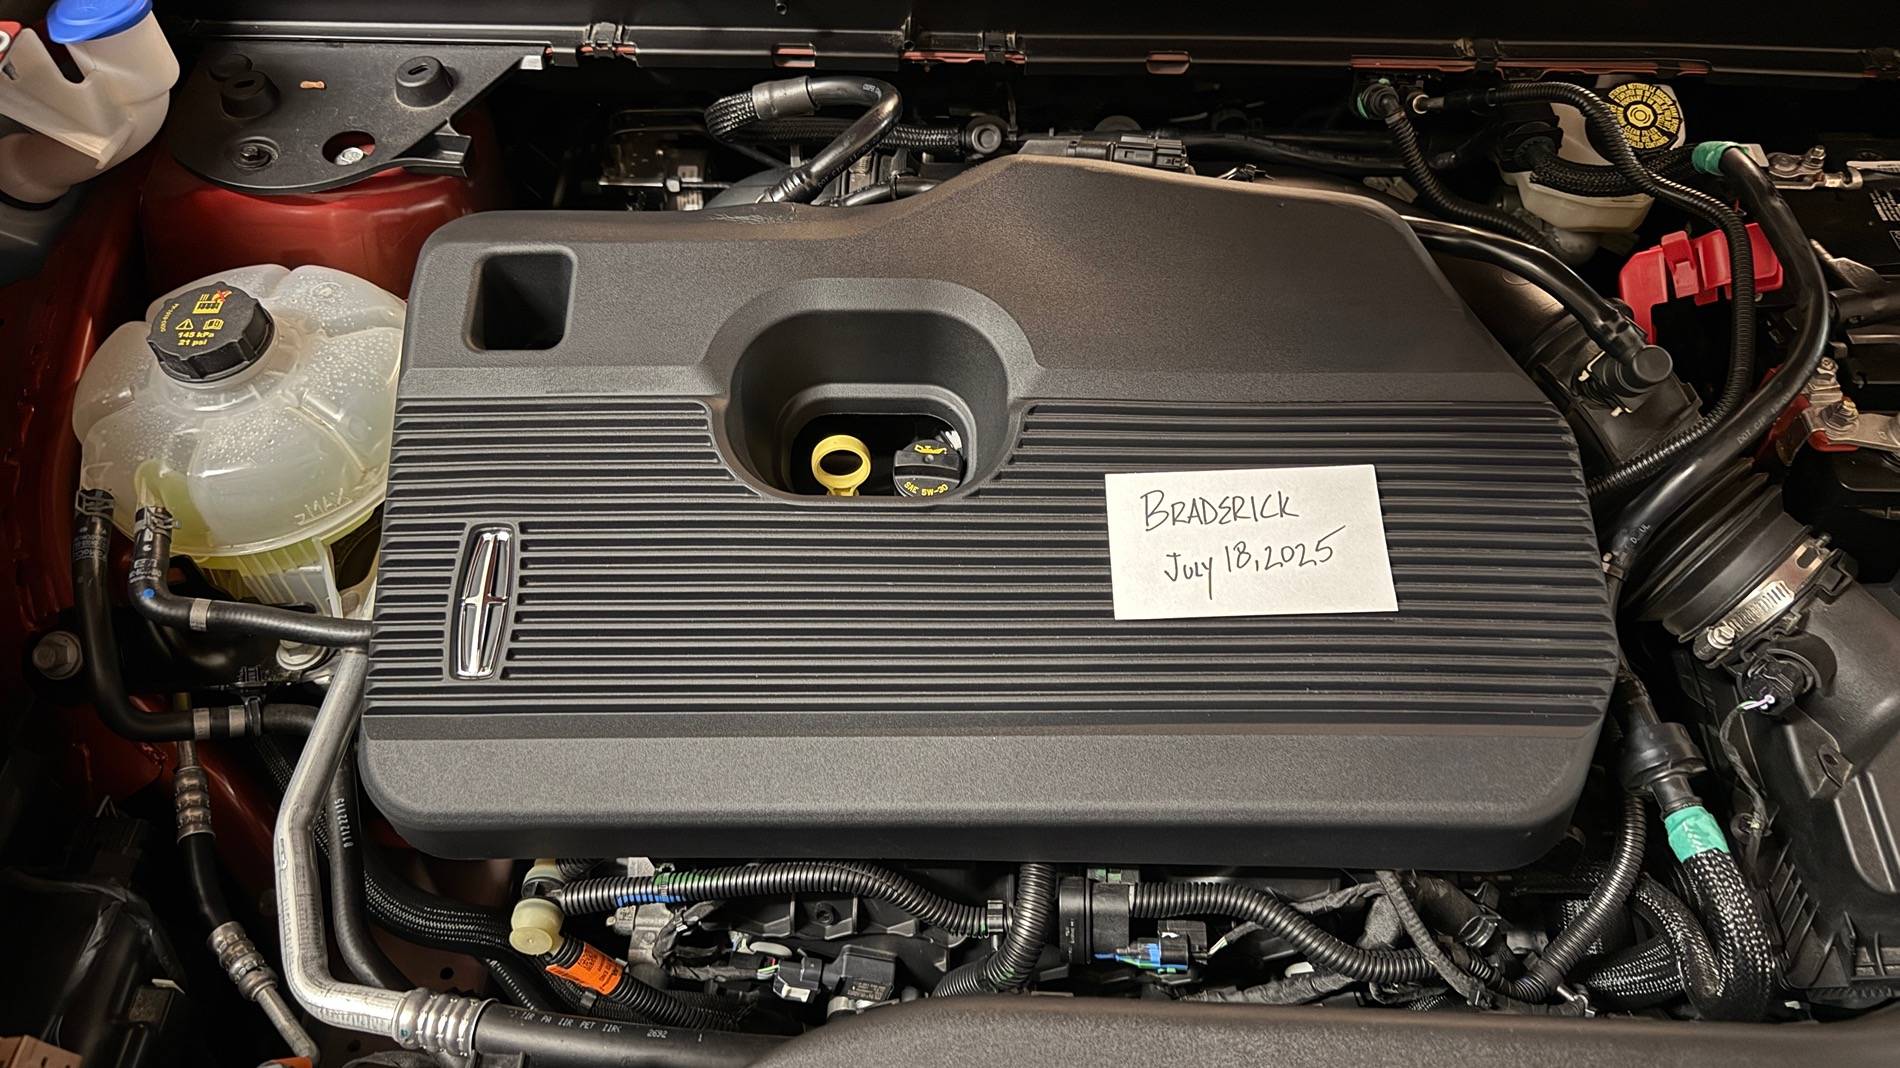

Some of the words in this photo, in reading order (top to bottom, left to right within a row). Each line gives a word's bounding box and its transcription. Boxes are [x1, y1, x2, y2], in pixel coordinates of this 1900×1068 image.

[178, 331, 195, 339] 145
[904, 481, 919, 494] SAE
[921, 483, 949, 497] 5W-30
